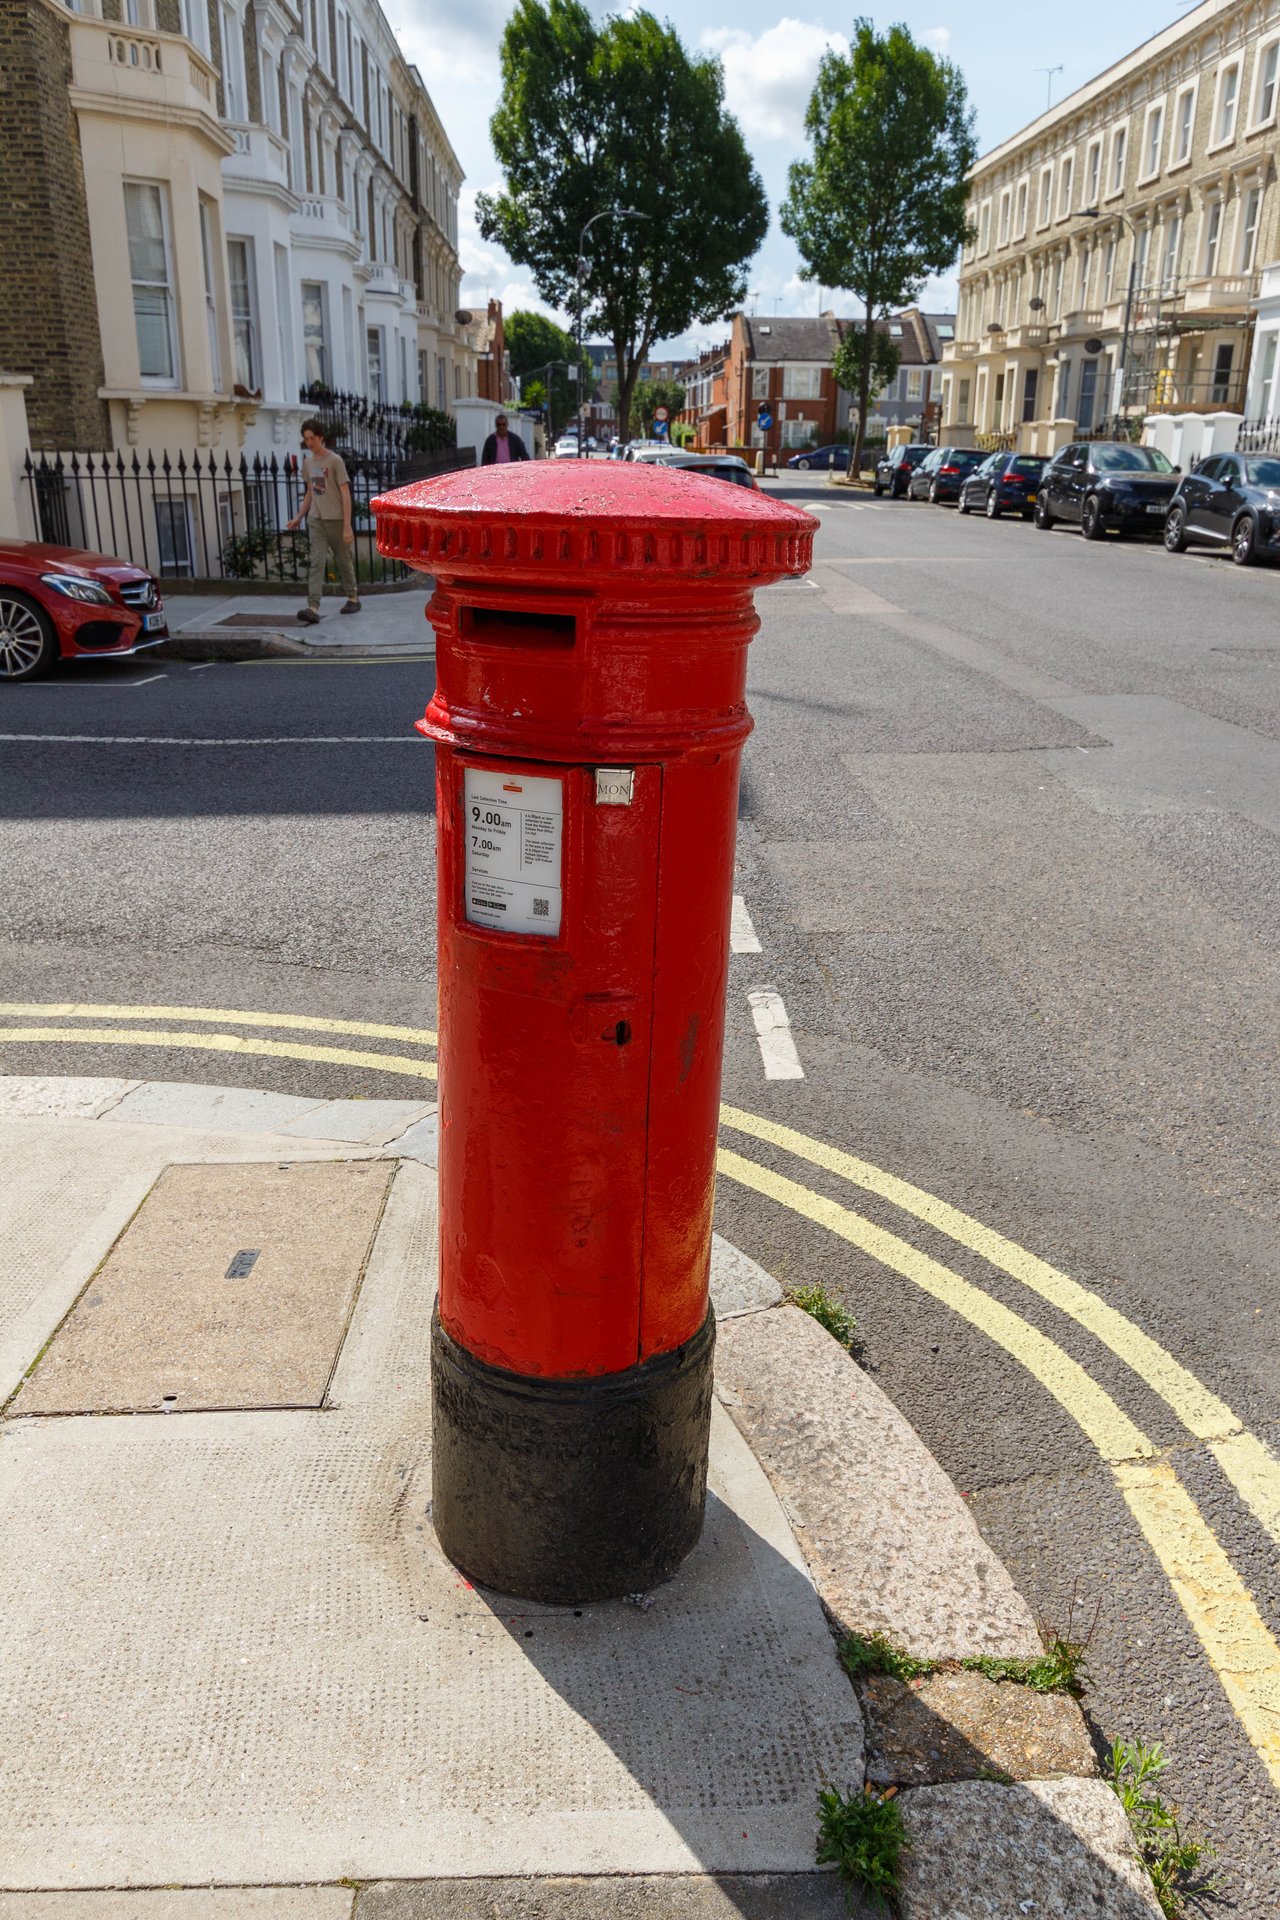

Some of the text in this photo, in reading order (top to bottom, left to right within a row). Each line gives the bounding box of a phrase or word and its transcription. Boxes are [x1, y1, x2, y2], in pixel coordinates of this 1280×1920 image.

[598, 784, 629, 795] MON
[472, 807, 511, 828] 9.00am
[472, 836, 501, 851] 7.00am
[472, 850, 490, 858] Saturday
